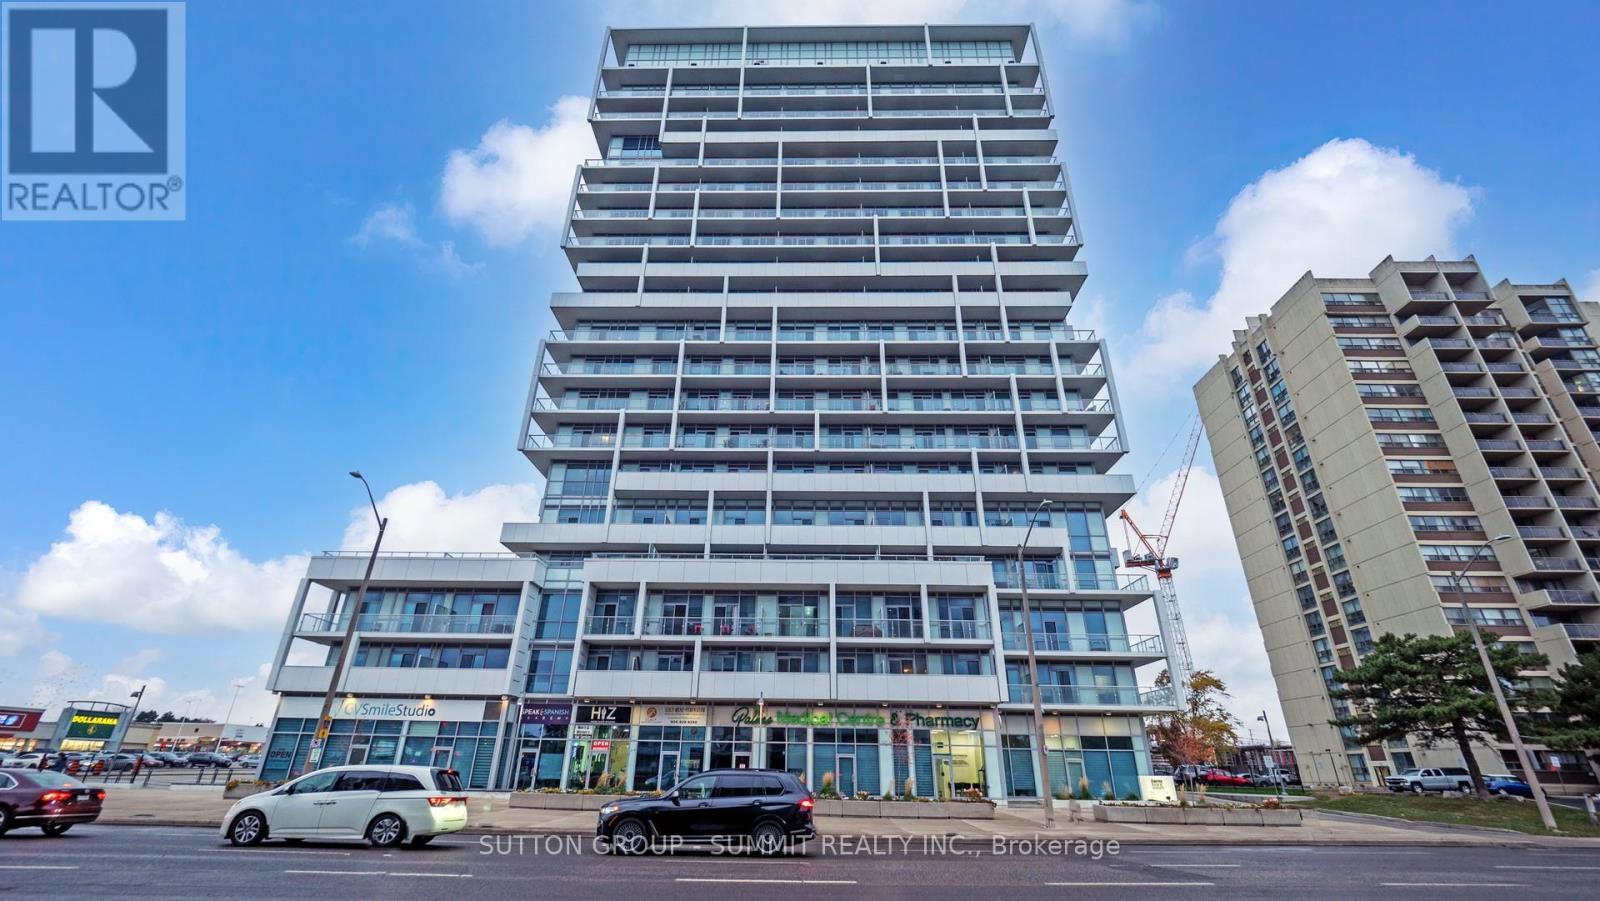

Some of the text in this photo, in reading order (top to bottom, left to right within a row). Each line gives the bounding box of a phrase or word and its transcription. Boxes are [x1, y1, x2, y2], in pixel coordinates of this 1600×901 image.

[544, 708, 570, 716] SPANISH
[71, 715, 118, 725] DOLLARAMA
[776, 710, 832, 726] Medical
[836, 711, 886, 727] Centre
[905, 712, 980, 731] Pharmacy
